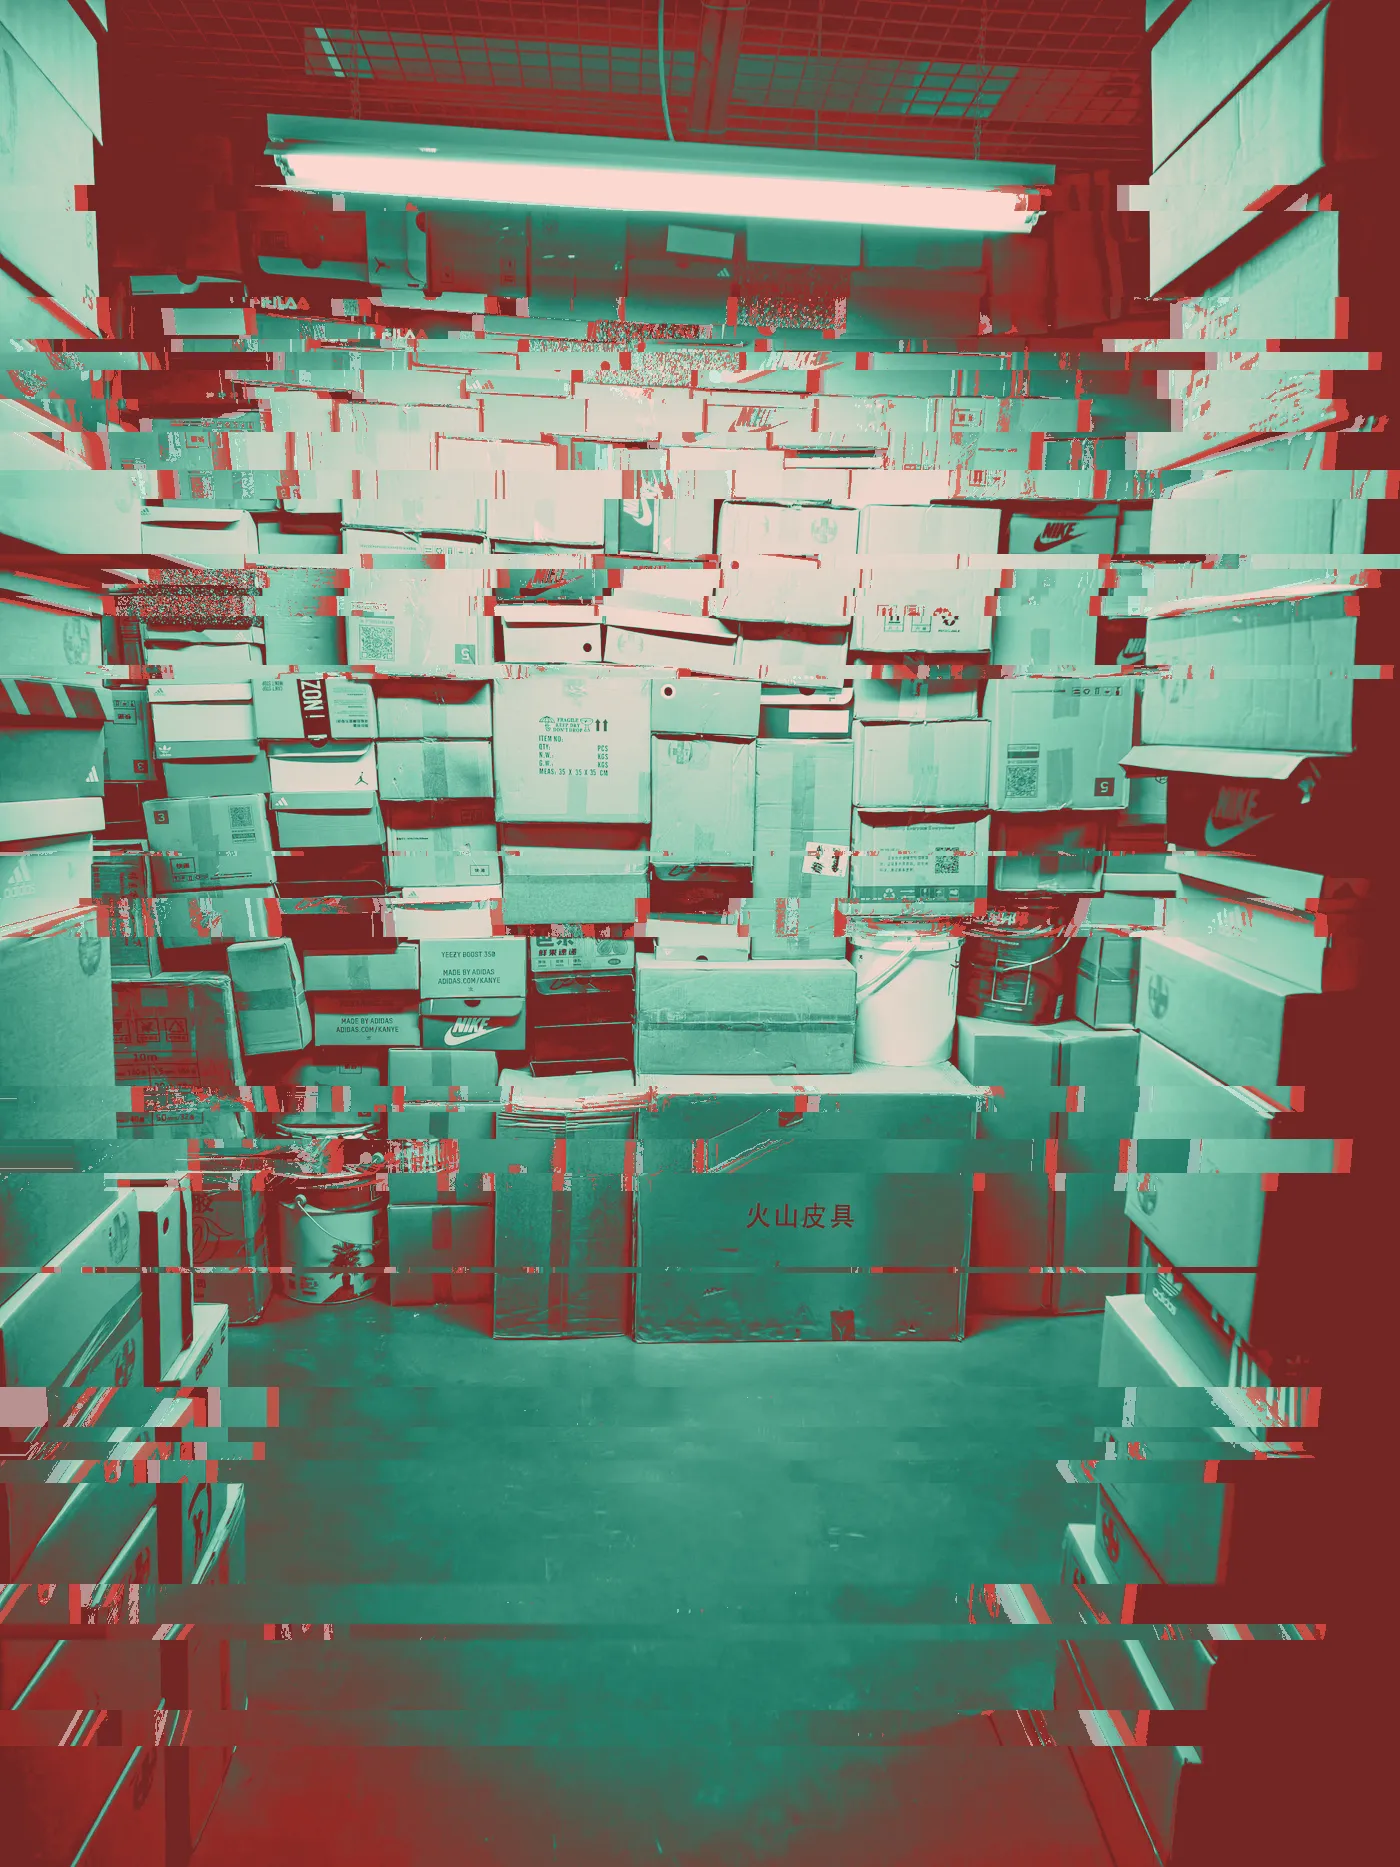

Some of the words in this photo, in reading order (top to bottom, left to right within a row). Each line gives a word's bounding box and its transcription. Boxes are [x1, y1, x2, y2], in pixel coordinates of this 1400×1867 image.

[1041, 522, 1079, 540] NIKE
[538, 743, 551, 751] QTY:
[597, 744, 609, 752] PCS
[558, 768, 566, 776] 35
[589, 769, 597, 777] 35
[599, 769, 609, 777] CM
[1215, 787, 1260, 822] NIKE
[158, 813, 166, 822] 3
[441, 951, 461, 959] YEEZY
[442, 968, 461, 976] MADE
[462, 968, 471, 976] BY
[472, 968, 495, 976] ADIDAS
[438, 977, 500, 985] ADIDAS.COM/KANYE
[341, 1017, 359, 1025] MADE
[360, 1017, 369, 1025] BY
[370, 1017, 394, 1025] ADIDAS
[451, 1017, 491, 1034] NIKE
[746, 1202, 855, 1229] 火山皮具
